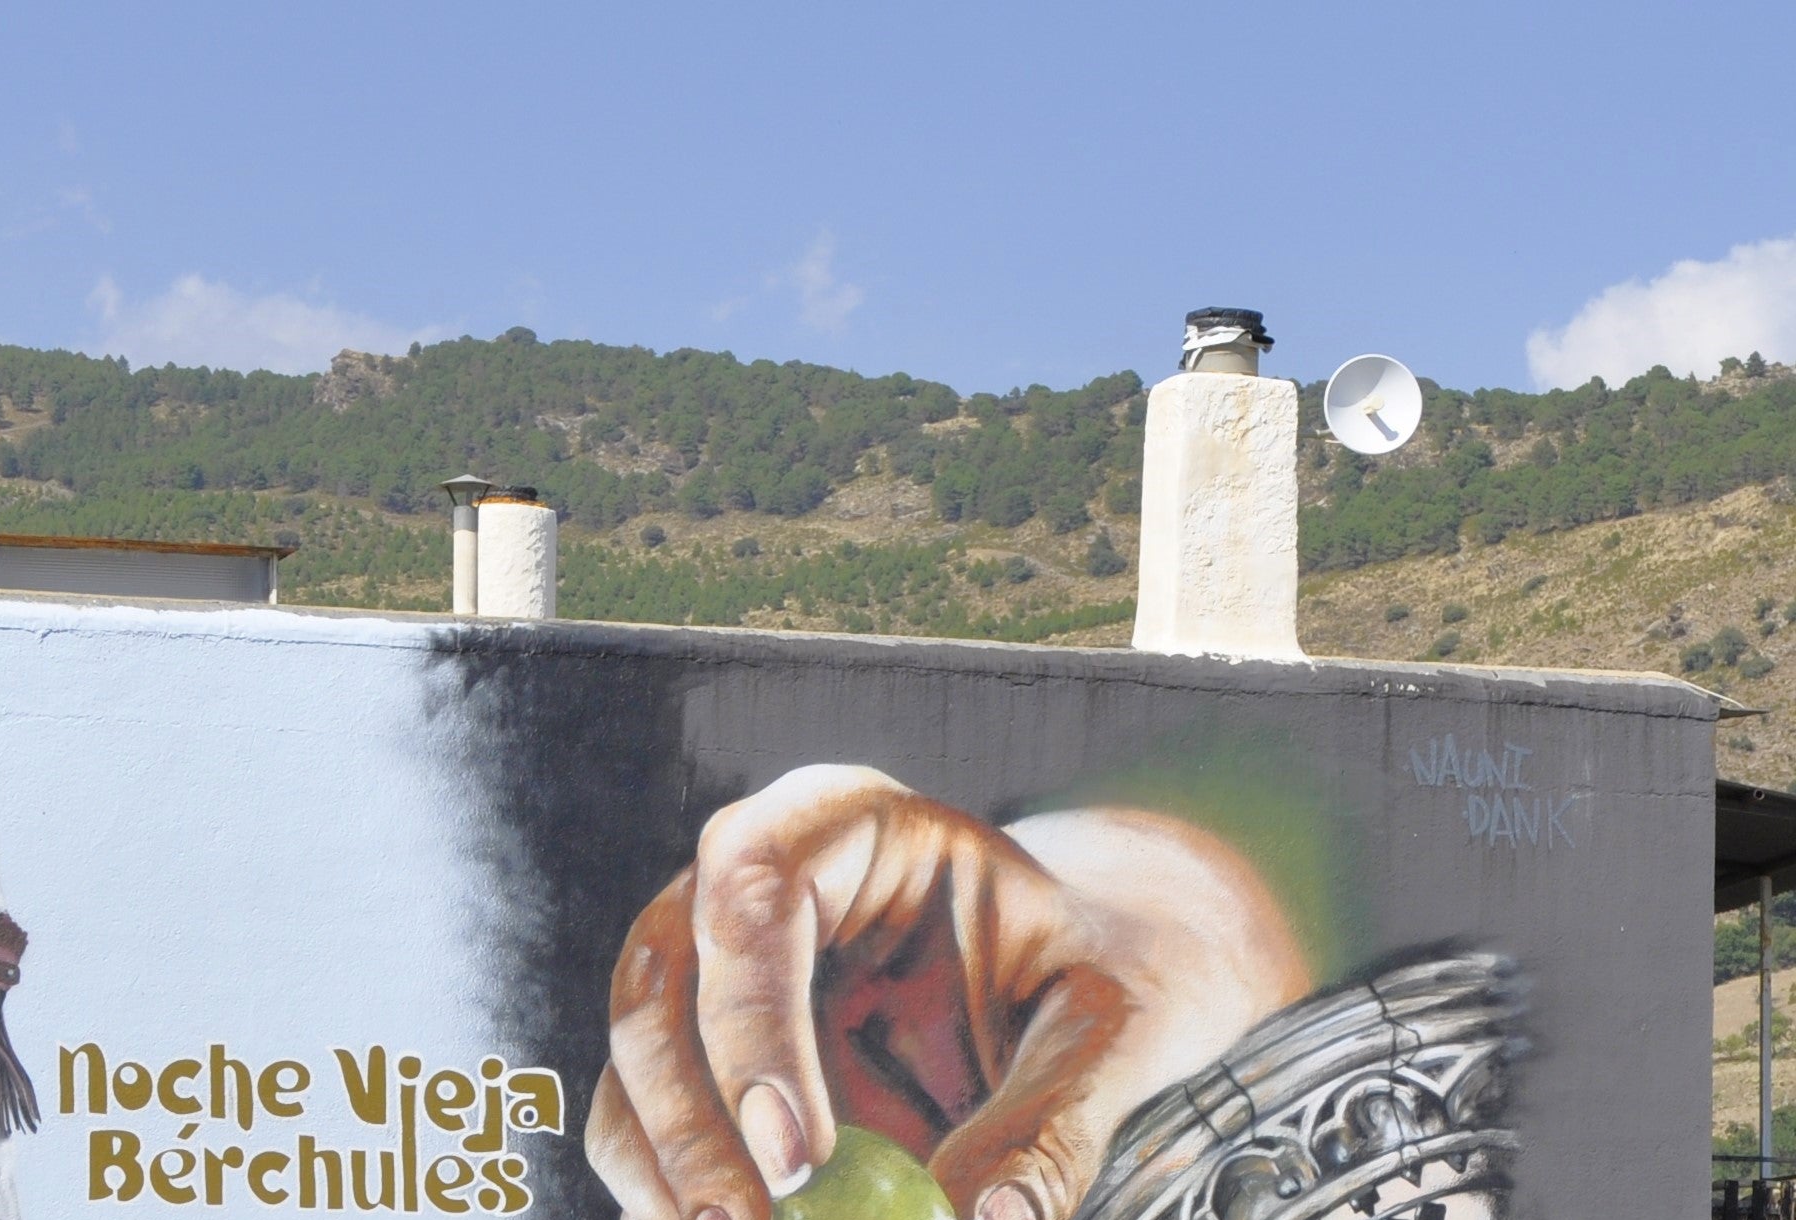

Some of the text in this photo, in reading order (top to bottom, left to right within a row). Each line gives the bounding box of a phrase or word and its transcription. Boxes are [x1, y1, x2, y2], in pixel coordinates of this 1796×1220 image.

[1466, 793, 1576, 849] DANK
[333, 1044, 564, 1152] Vieja
[88, 1123, 532, 1214] Bérchules
